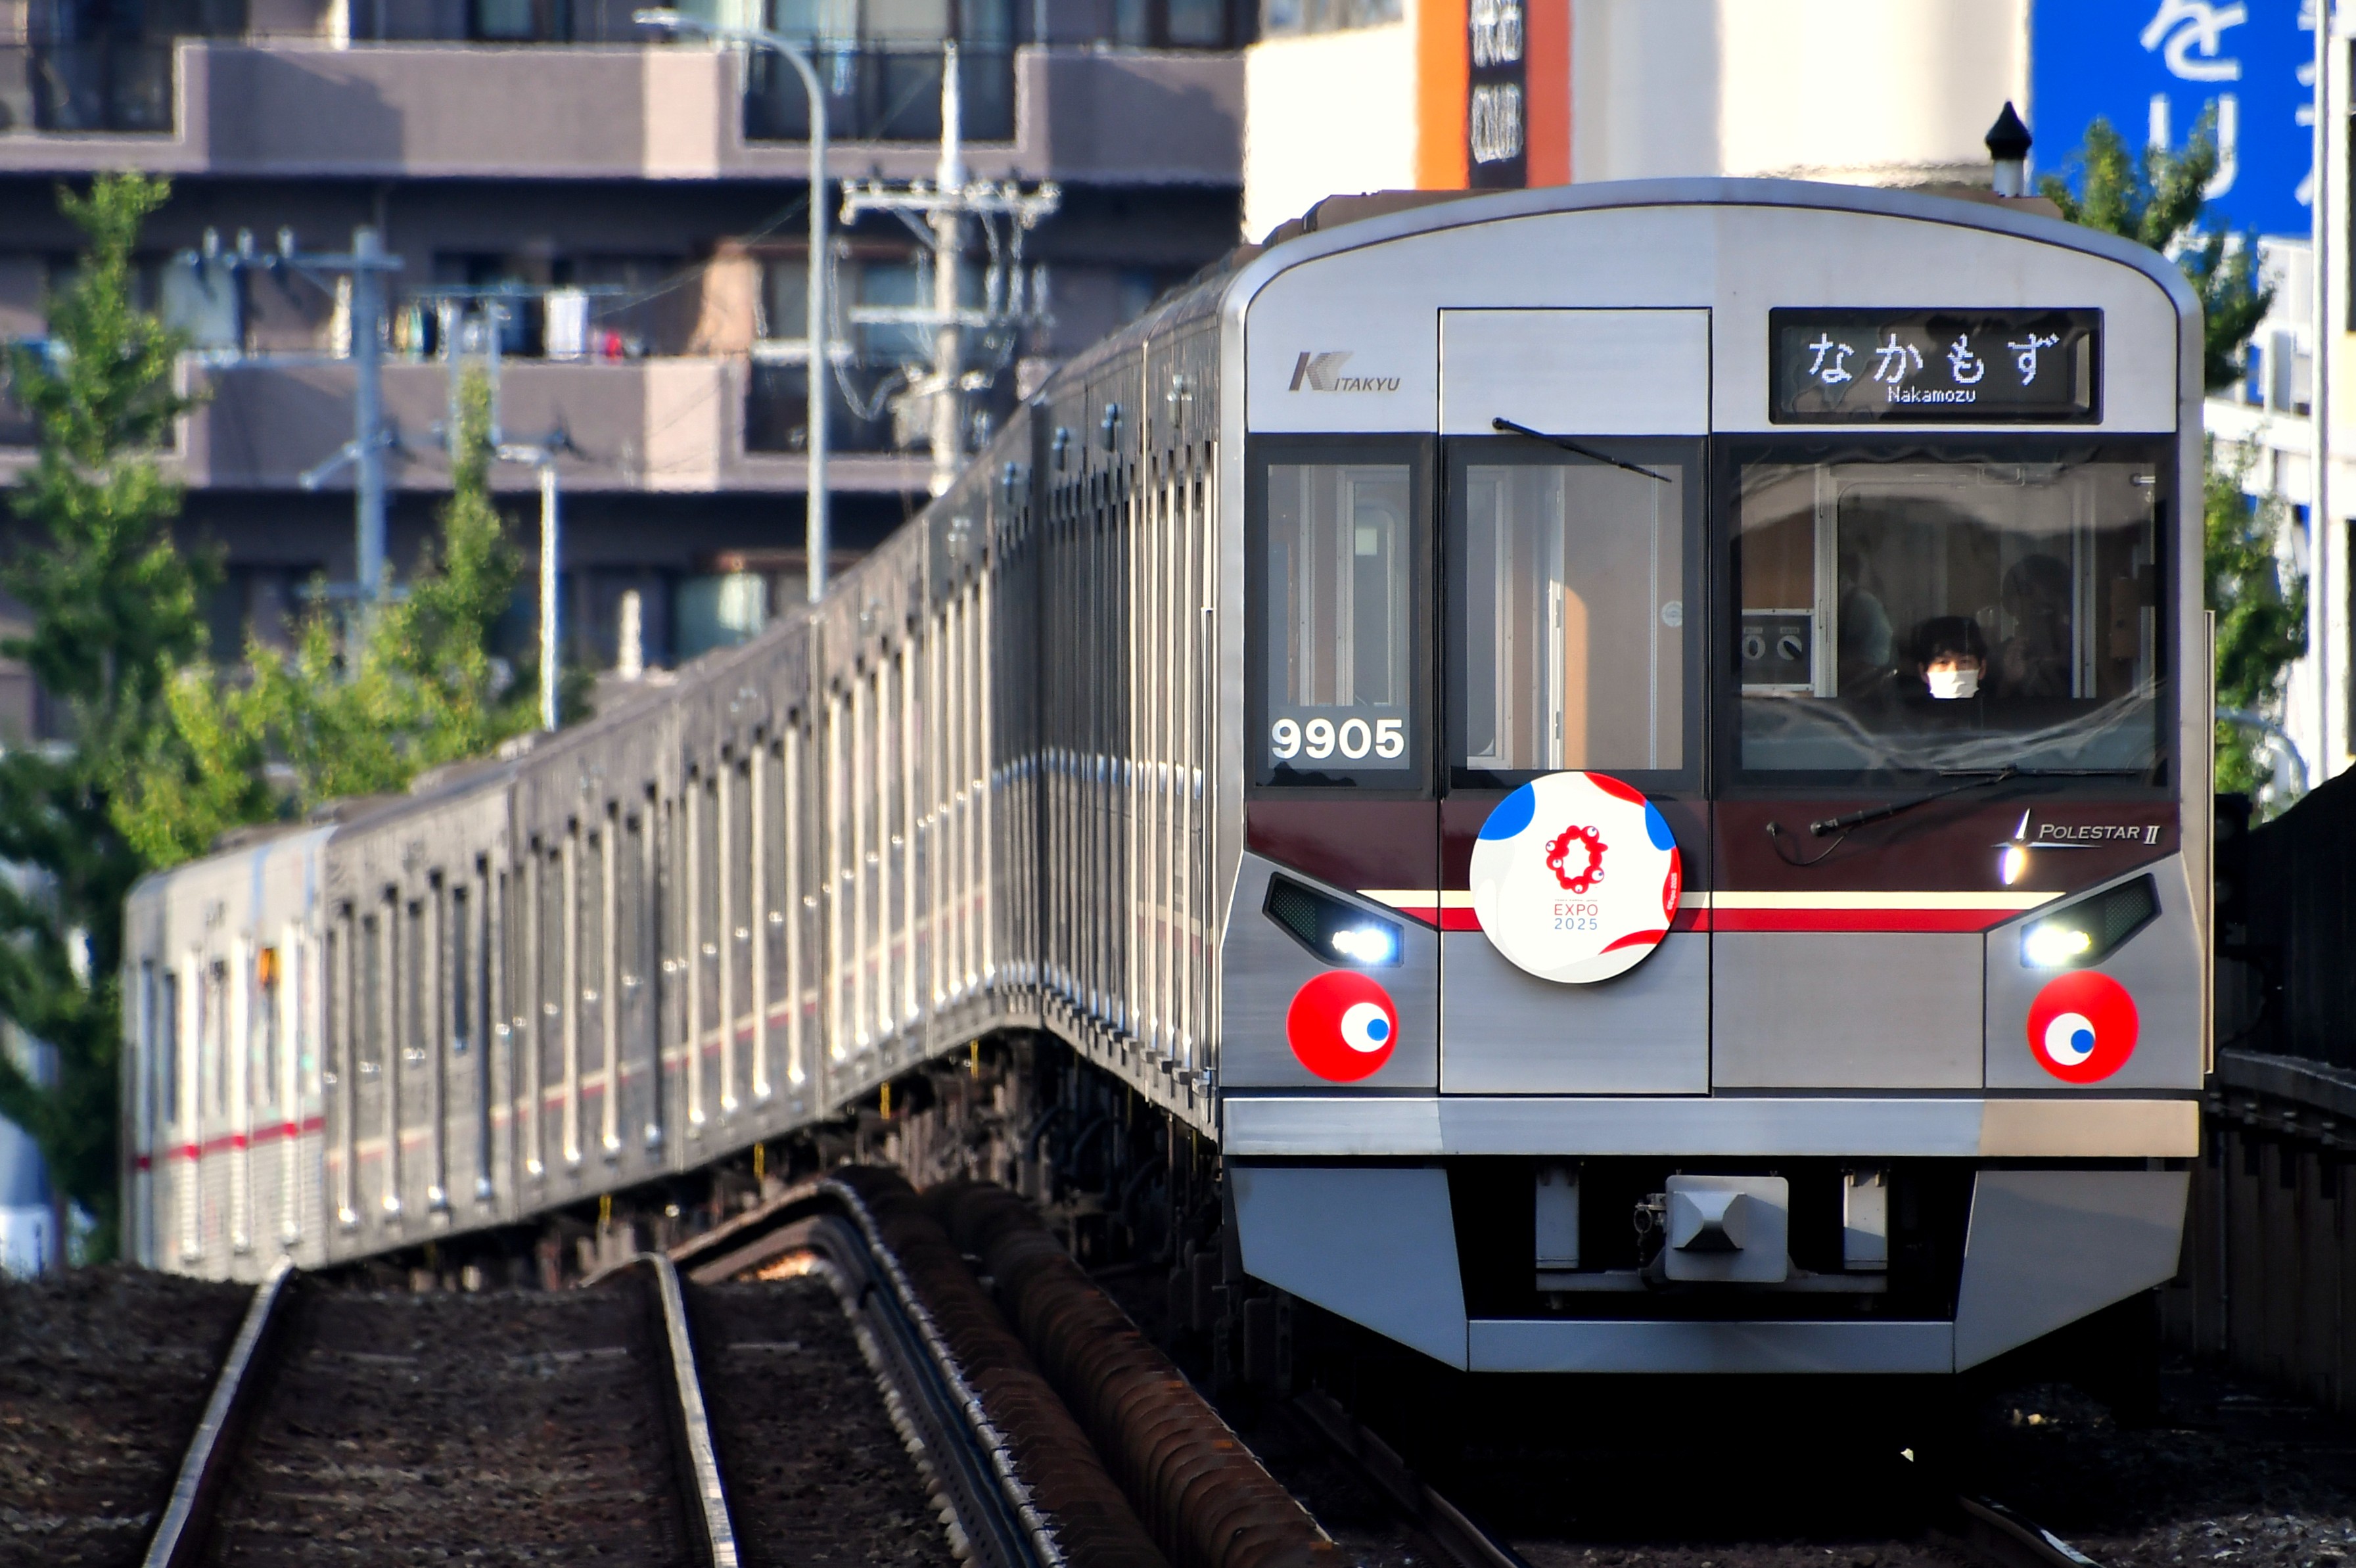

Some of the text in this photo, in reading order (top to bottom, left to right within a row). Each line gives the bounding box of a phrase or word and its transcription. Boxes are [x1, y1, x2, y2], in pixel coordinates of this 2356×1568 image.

[1809, 333, 2060, 385] なかもず
[1289, 352, 1400, 392] KITAKYU
[1888, 386, 1975, 403] Nakamozu
[1272, 719, 1405, 758] 9905
[2039, 824, 2139, 839] POLESTAR
[1554, 904, 1598, 916] EXPO
[1554, 917, 1598, 930] 2025
